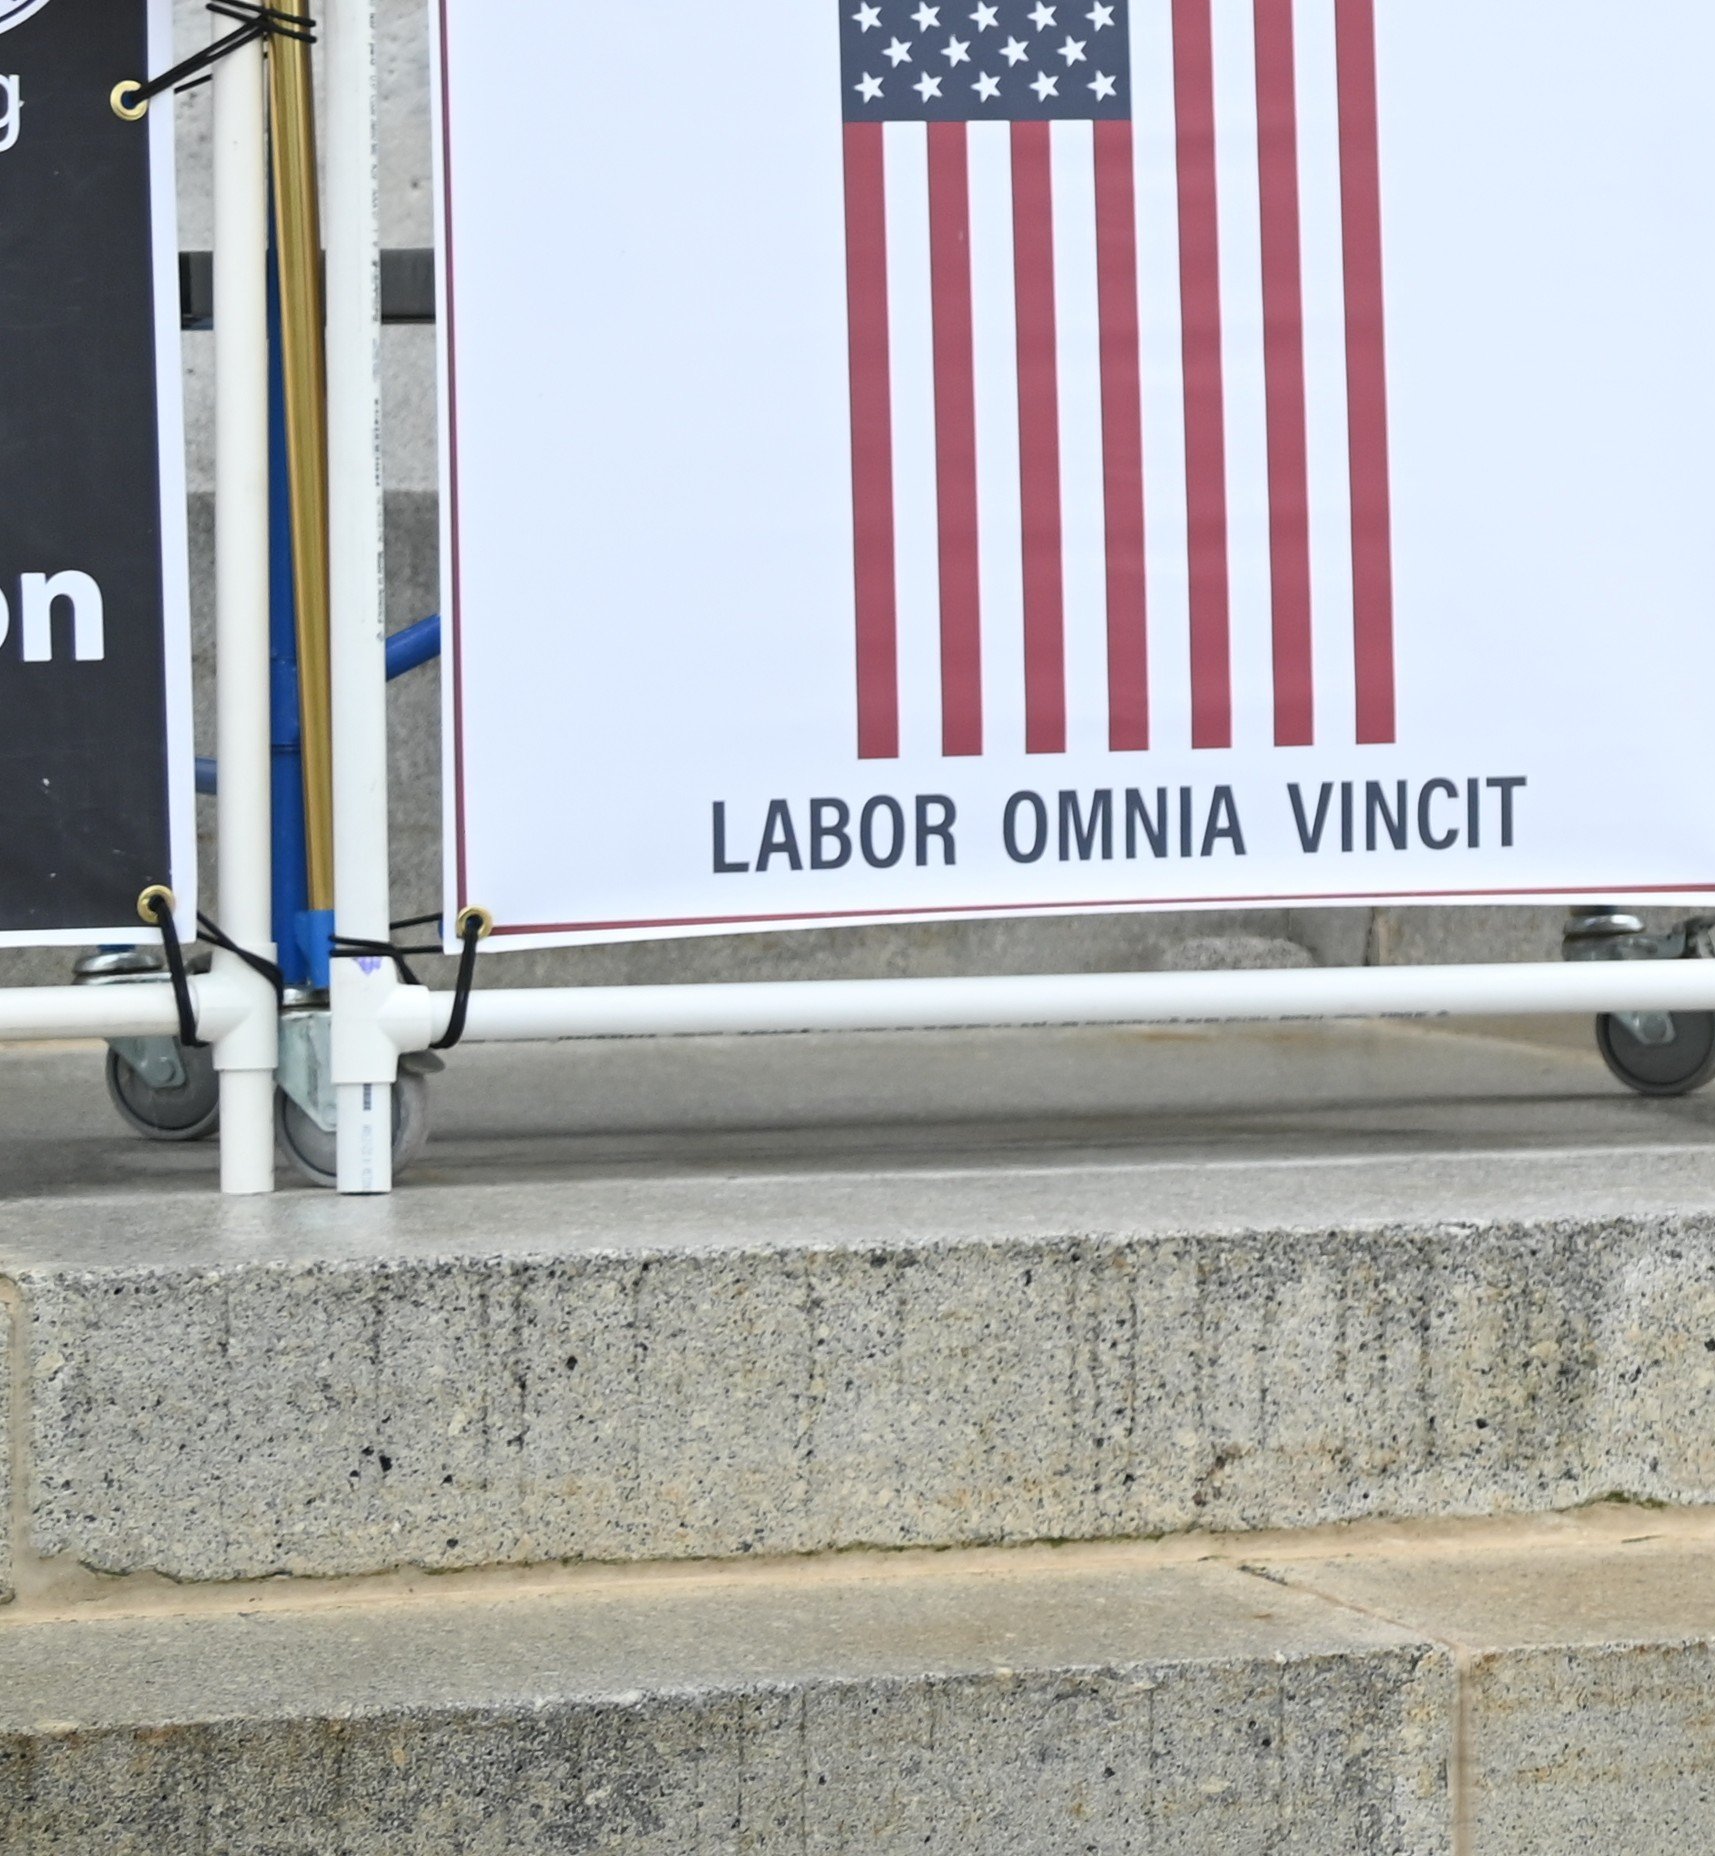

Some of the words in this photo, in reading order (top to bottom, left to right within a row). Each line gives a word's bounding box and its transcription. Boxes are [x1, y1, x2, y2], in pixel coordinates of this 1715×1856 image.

[711, 793, 958, 874] LABOR
[1002, 785, 1248, 865] OMNIA
[1286, 774, 1528, 854] VINCIT
